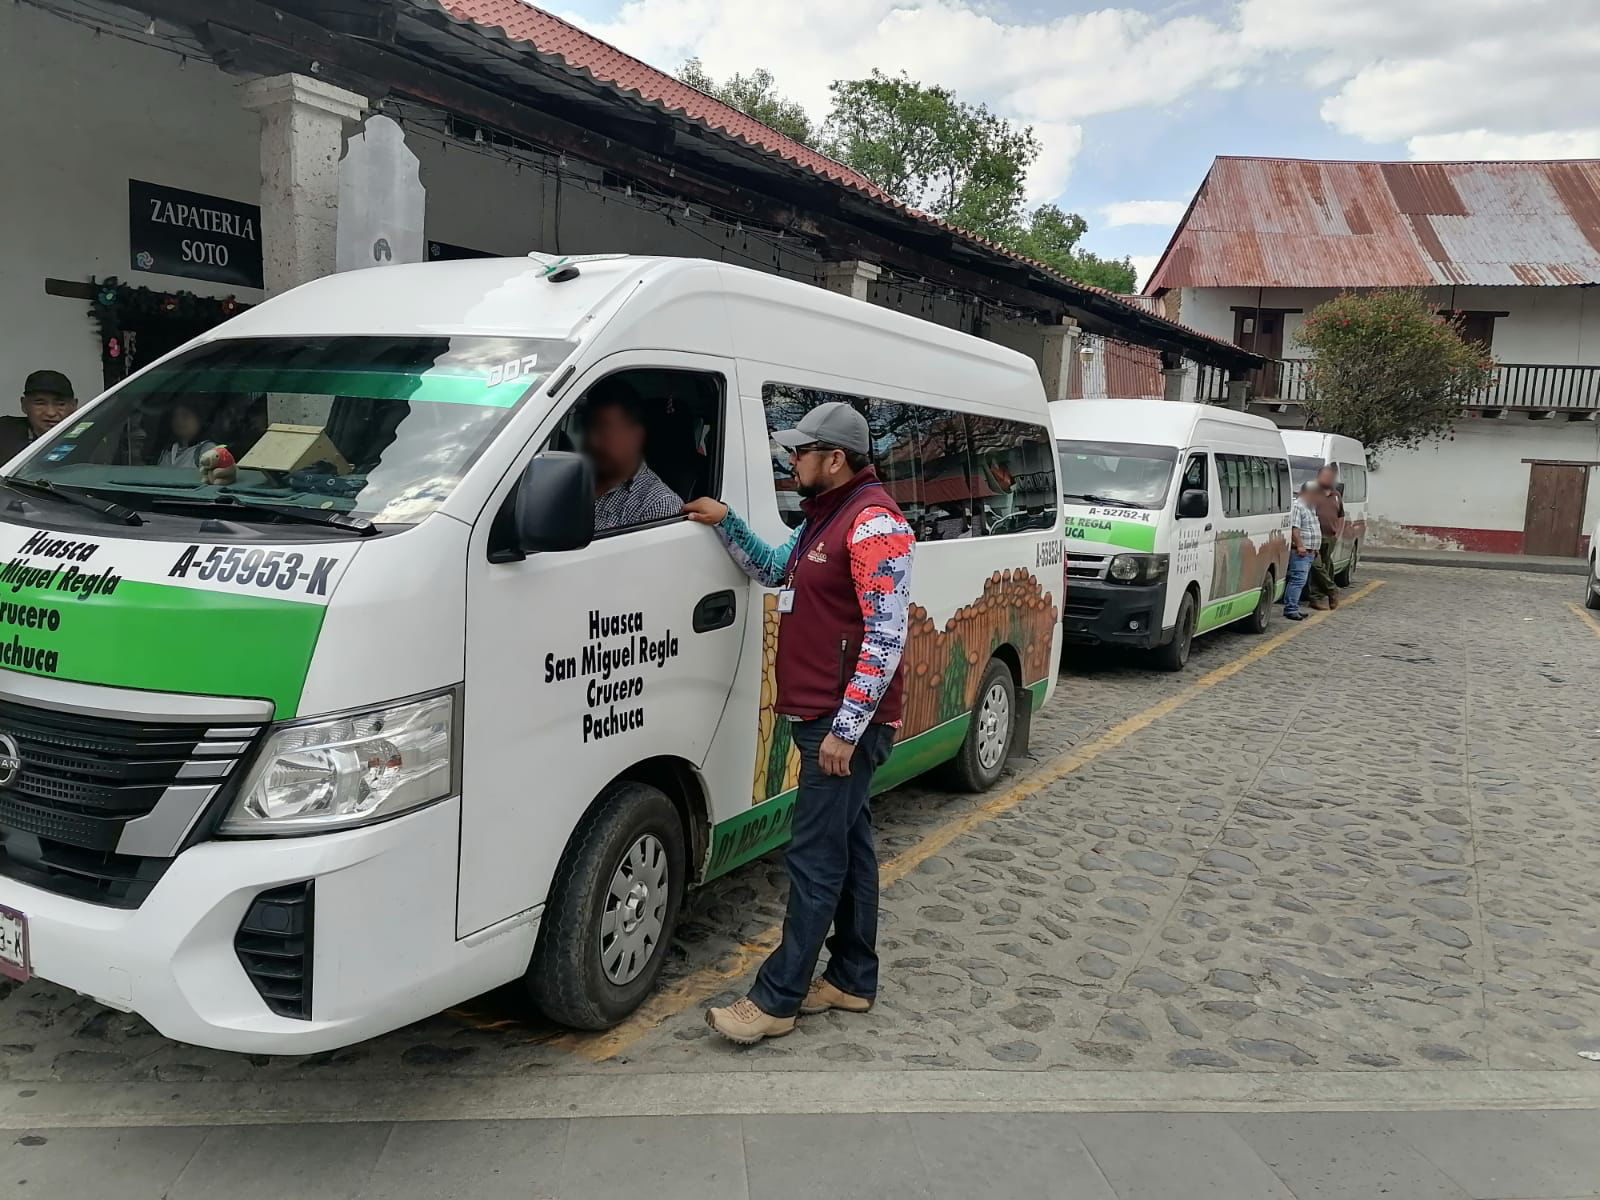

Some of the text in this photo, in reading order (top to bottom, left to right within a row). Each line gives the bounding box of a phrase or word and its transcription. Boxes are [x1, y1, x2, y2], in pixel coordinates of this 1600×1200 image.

[150, 198, 255, 241] ZAPATERIA
[181, 239, 229, 267] SOTO
[1078, 517, 1112, 531] REGLA
[17, 530, 100, 562] Huasca
[0, 557, 122, 601] Miguel Regla
[167, 544, 339, 596] A-55953-K
[588, 610, 643, 640] Huasca
[544, 629, 678, 683] San Miguel Regla
[586, 676, 643, 708] Crucero
[583, 705, 644, 743] Pachuca
[0, 759, 19, 769] AN
